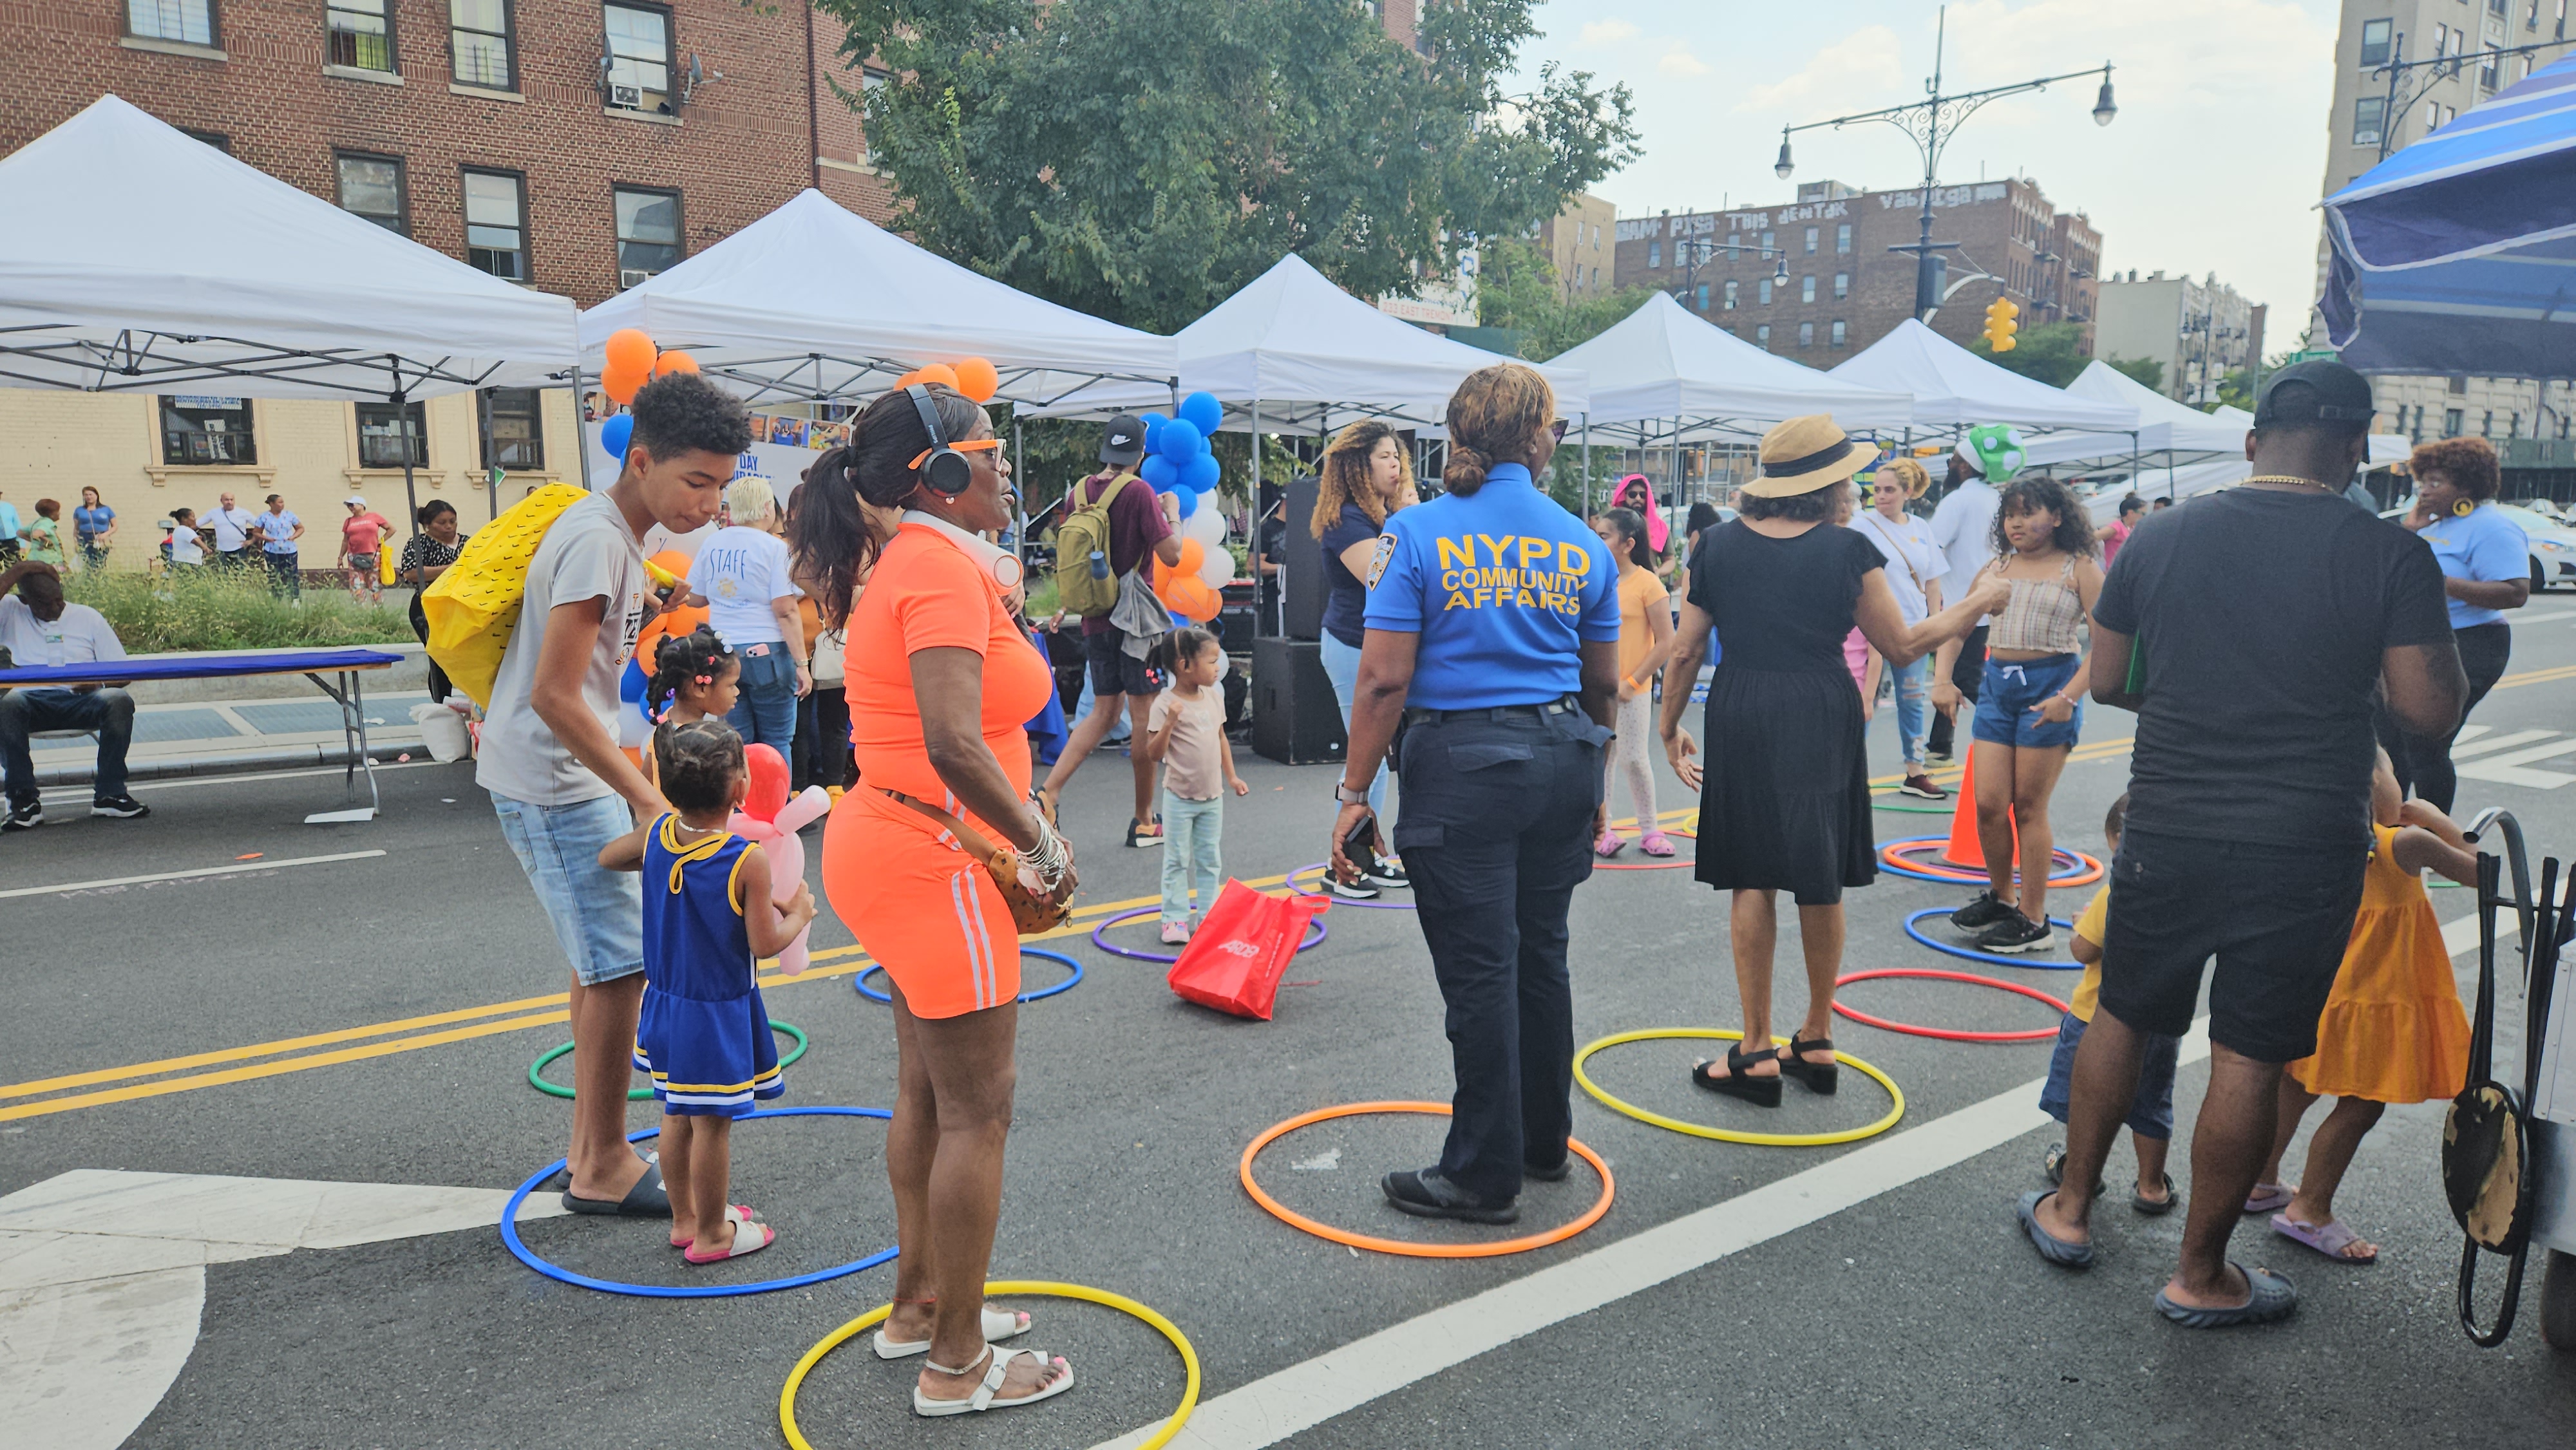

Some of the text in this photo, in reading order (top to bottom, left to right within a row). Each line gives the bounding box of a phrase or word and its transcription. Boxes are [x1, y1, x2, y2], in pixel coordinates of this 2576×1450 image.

[1401, 304, 1419, 316] EAST
[1421, 307, 1454, 321] TREMONT
[928, 424, 938, 444] PHILIPS
[739, 453, 758, 471] DAY
[710, 548, 747, 584] STAFF
[1436, 534, 1591, 576] NYPD
[1442, 567, 1589, 594] COMMUNITY
[1444, 587, 1580, 616] AFFAIRS
